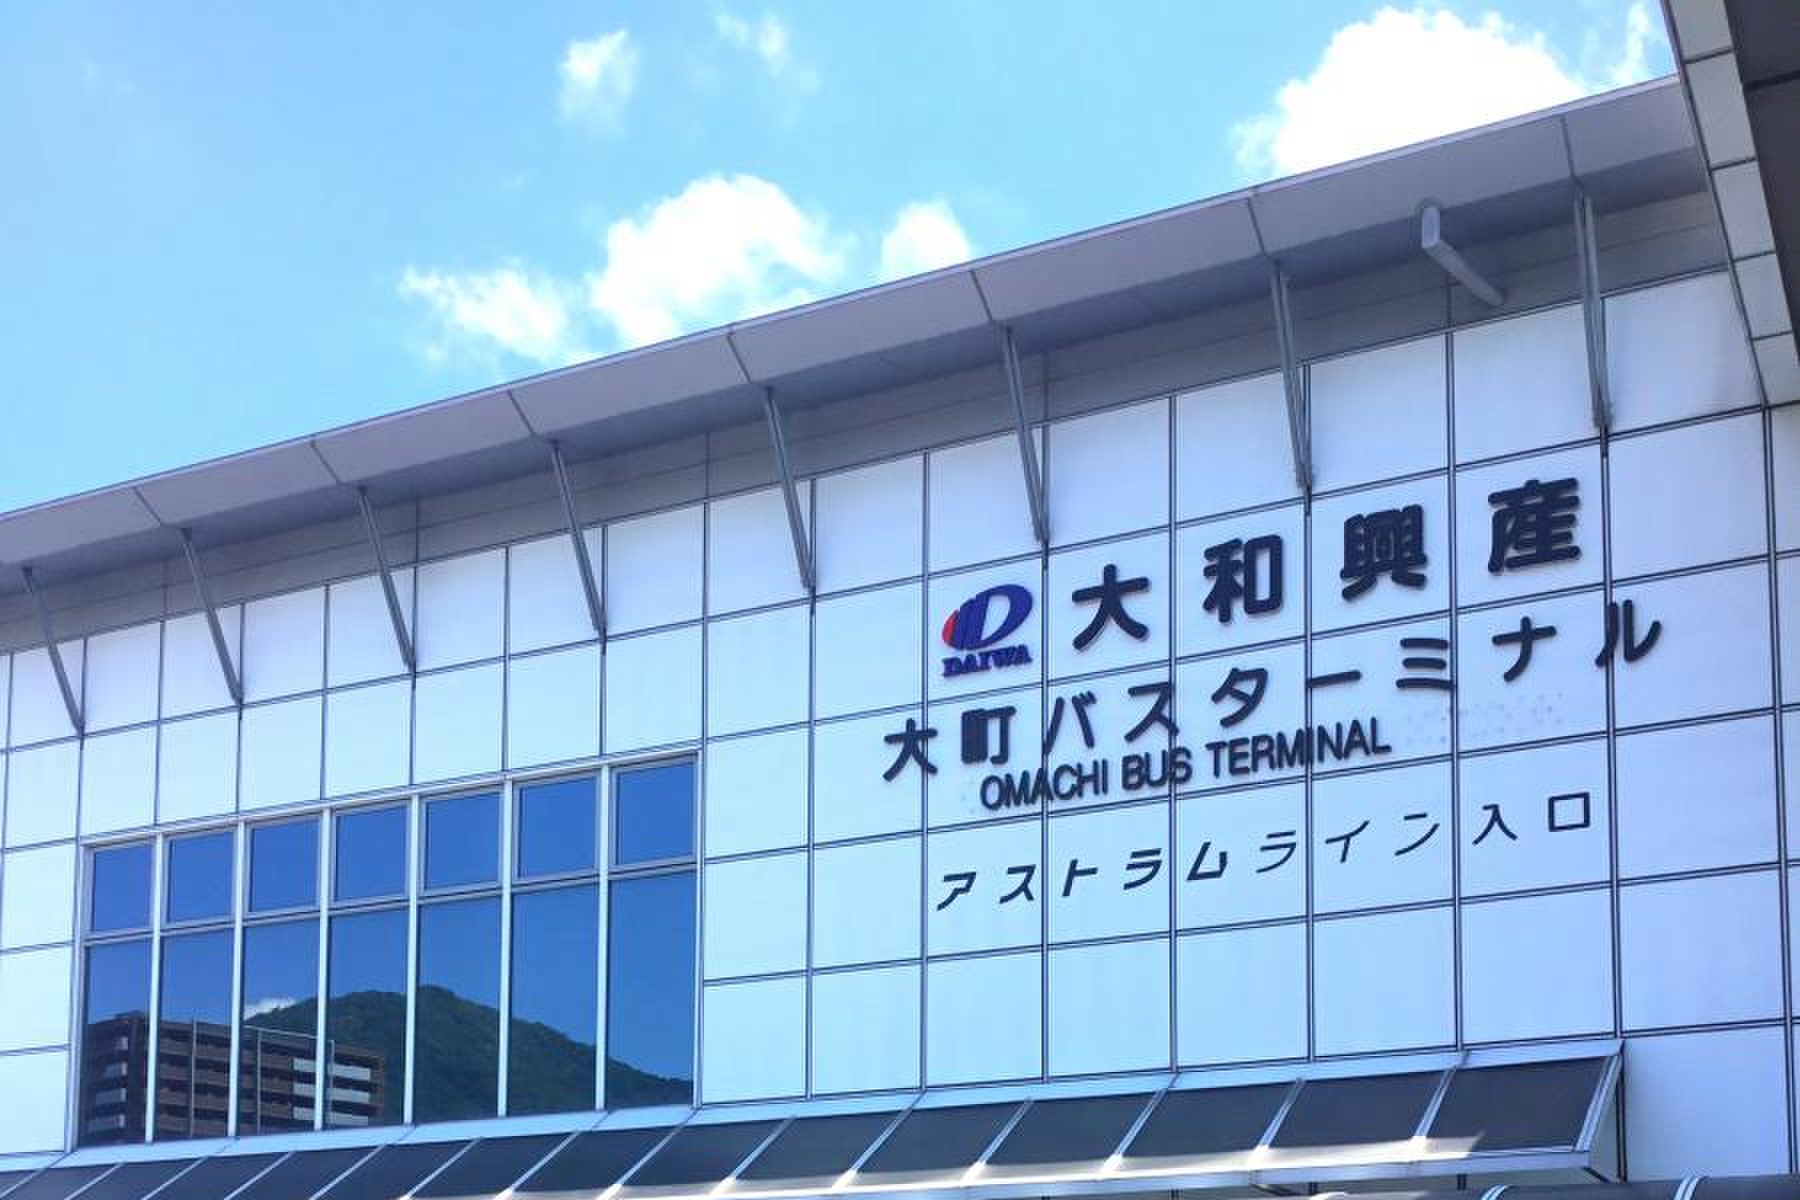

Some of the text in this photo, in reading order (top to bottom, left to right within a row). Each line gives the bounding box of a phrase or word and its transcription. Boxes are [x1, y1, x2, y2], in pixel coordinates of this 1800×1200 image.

[1072, 477, 1582, 650] 大和興産
[883, 598, 1662, 782] 大町バスターミナル
[941, 644, 1033, 678] DAIWA
[979, 716, 1393, 812] OMACHI BUS TERMINAL
[936, 791, 1591, 912] アストラムライン入口
